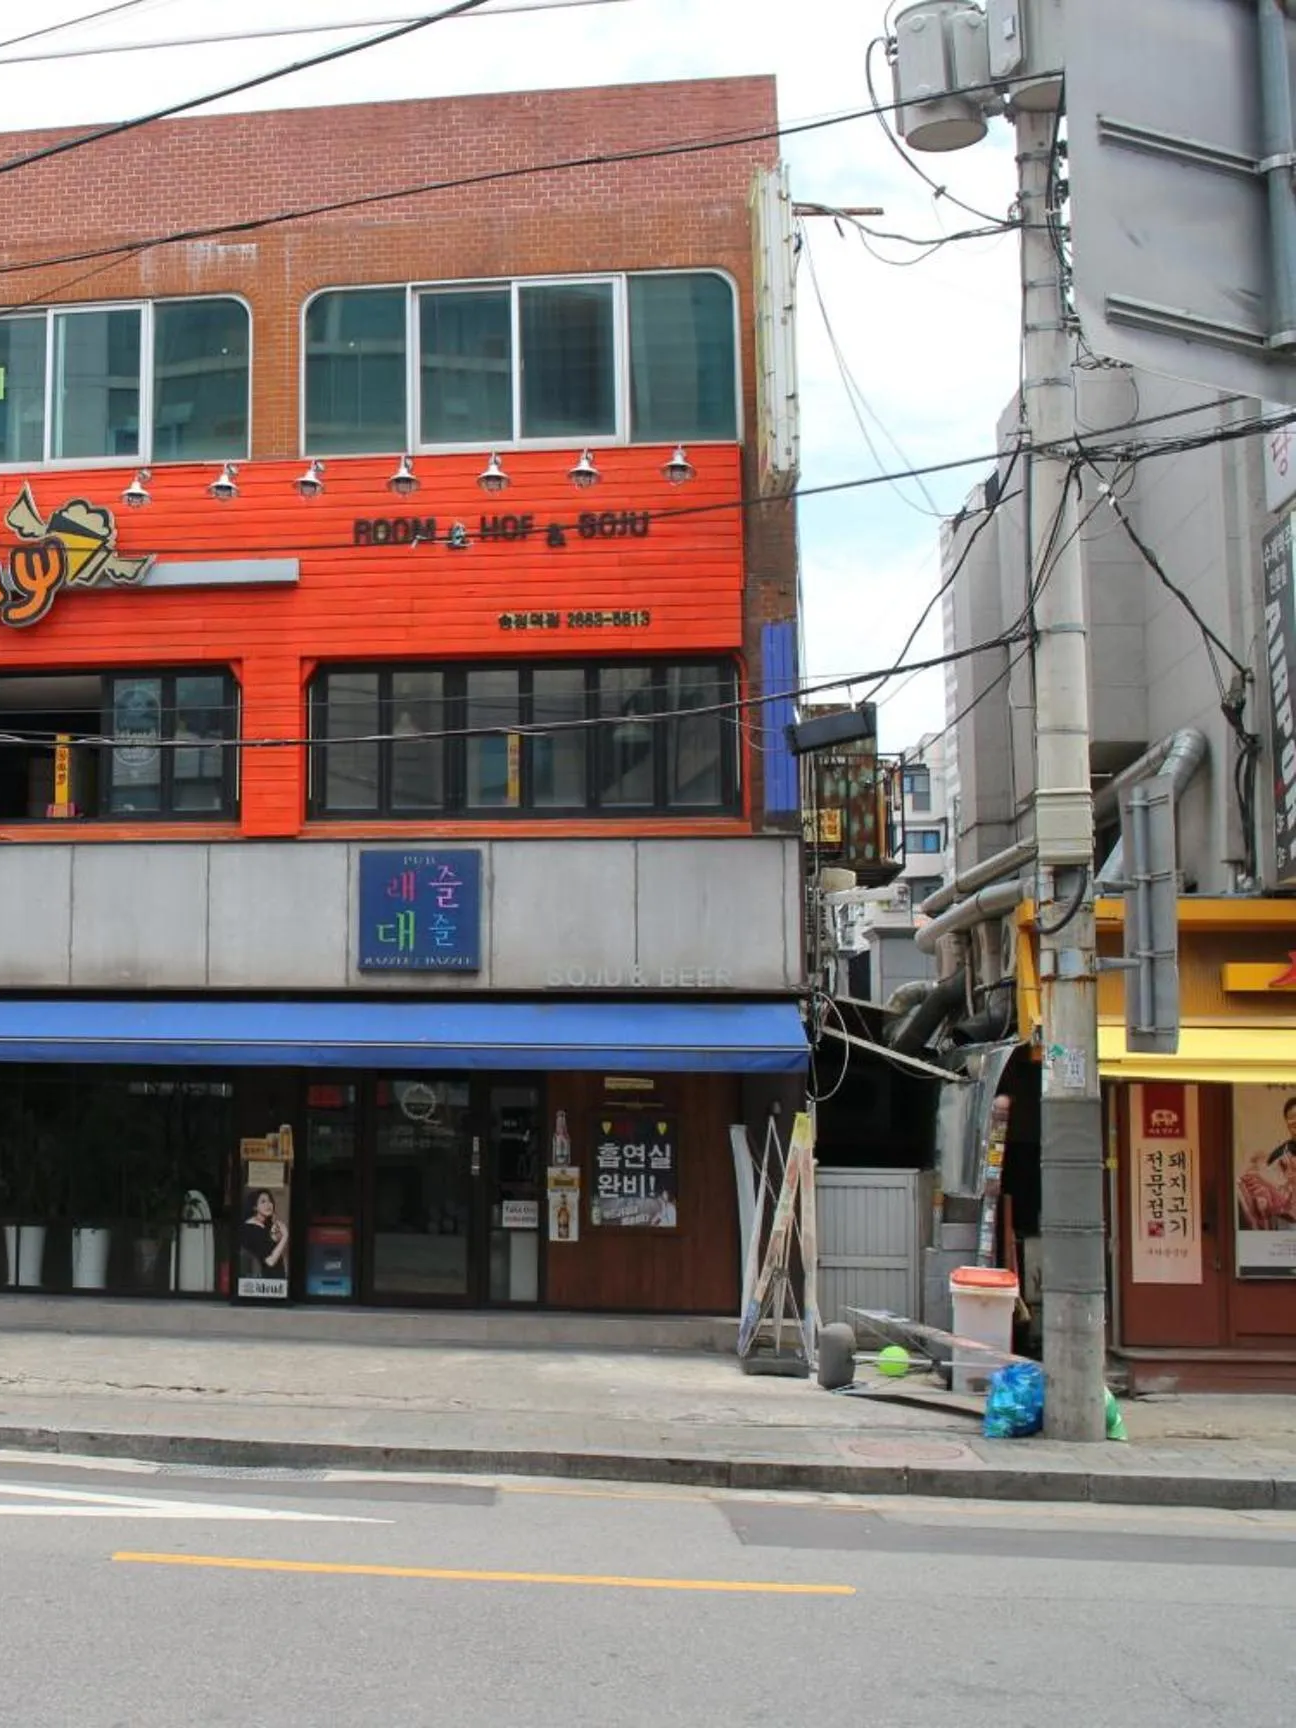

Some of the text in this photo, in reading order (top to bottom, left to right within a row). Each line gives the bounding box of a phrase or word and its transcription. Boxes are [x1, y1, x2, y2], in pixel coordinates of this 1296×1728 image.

[354, 518, 436, 546] ROOM
[480, 515, 534, 541] HOF
[578, 511, 649, 539] SOJU
[548, 964, 625, 987] SOJU
[660, 965, 733, 987] BEER
[597, 1142, 672, 1170] 흡연실
[597, 1174, 657, 1199] 완비!
[1145, 1150, 1167, 1220] 전문점
[1168, 1150, 1189, 1239] 돼지고기
